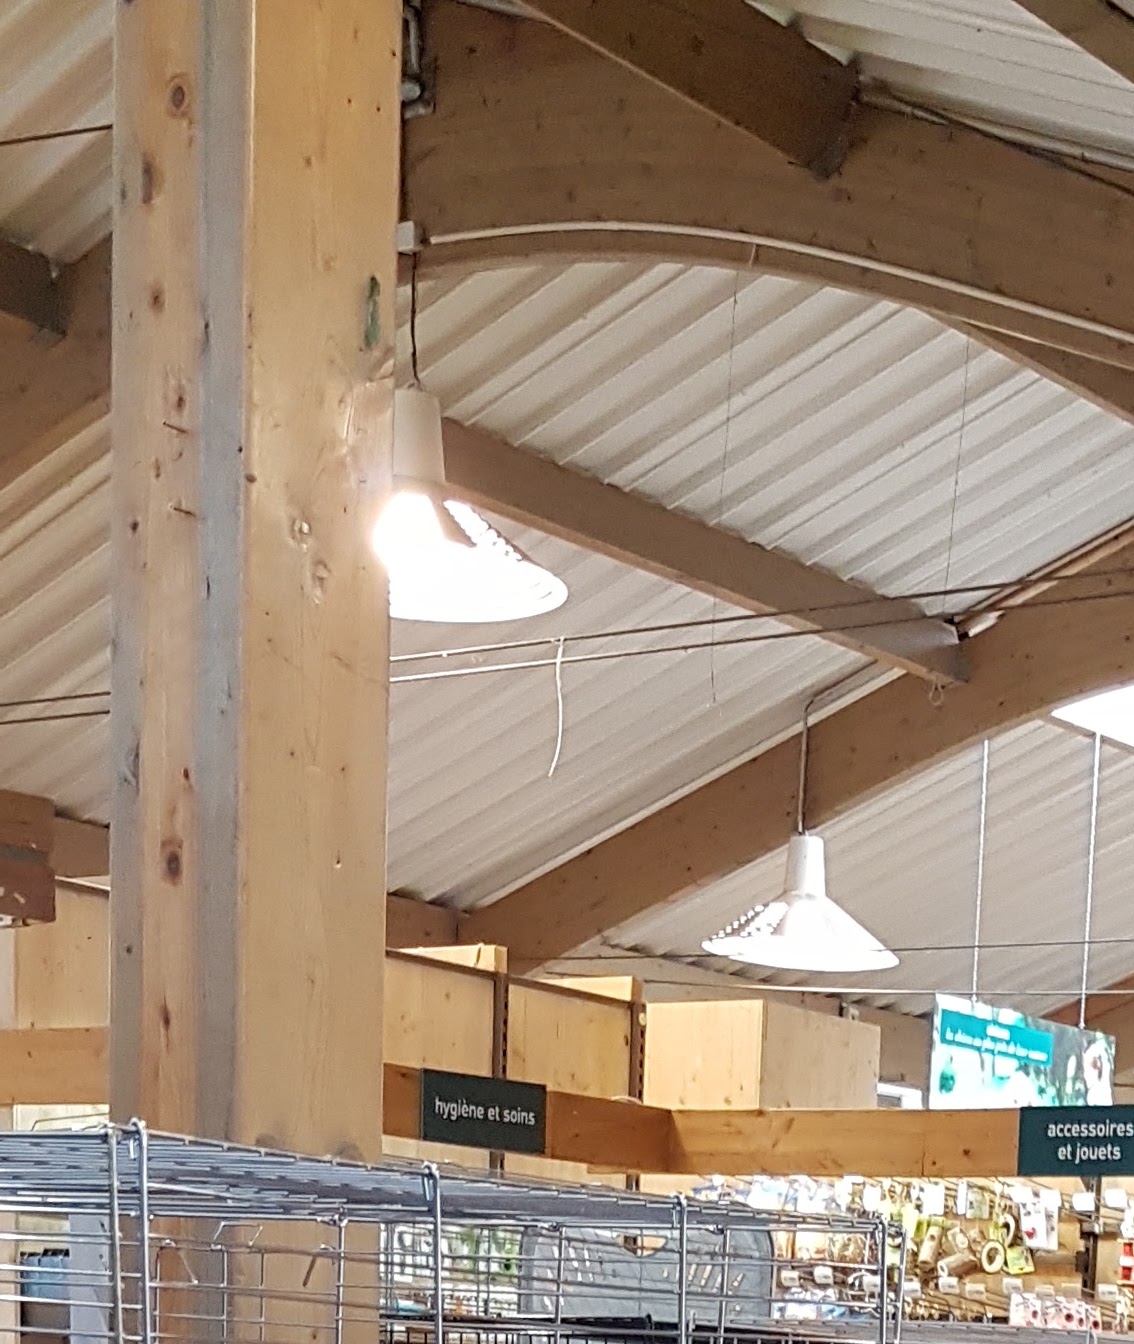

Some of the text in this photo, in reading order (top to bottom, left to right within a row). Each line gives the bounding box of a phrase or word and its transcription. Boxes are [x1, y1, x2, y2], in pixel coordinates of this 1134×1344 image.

[435, 1095, 535, 1125] hygiène et soins
[1047, 1118, 1134, 1138] accessoires
[1058, 1142, 1121, 1164] et jouets
